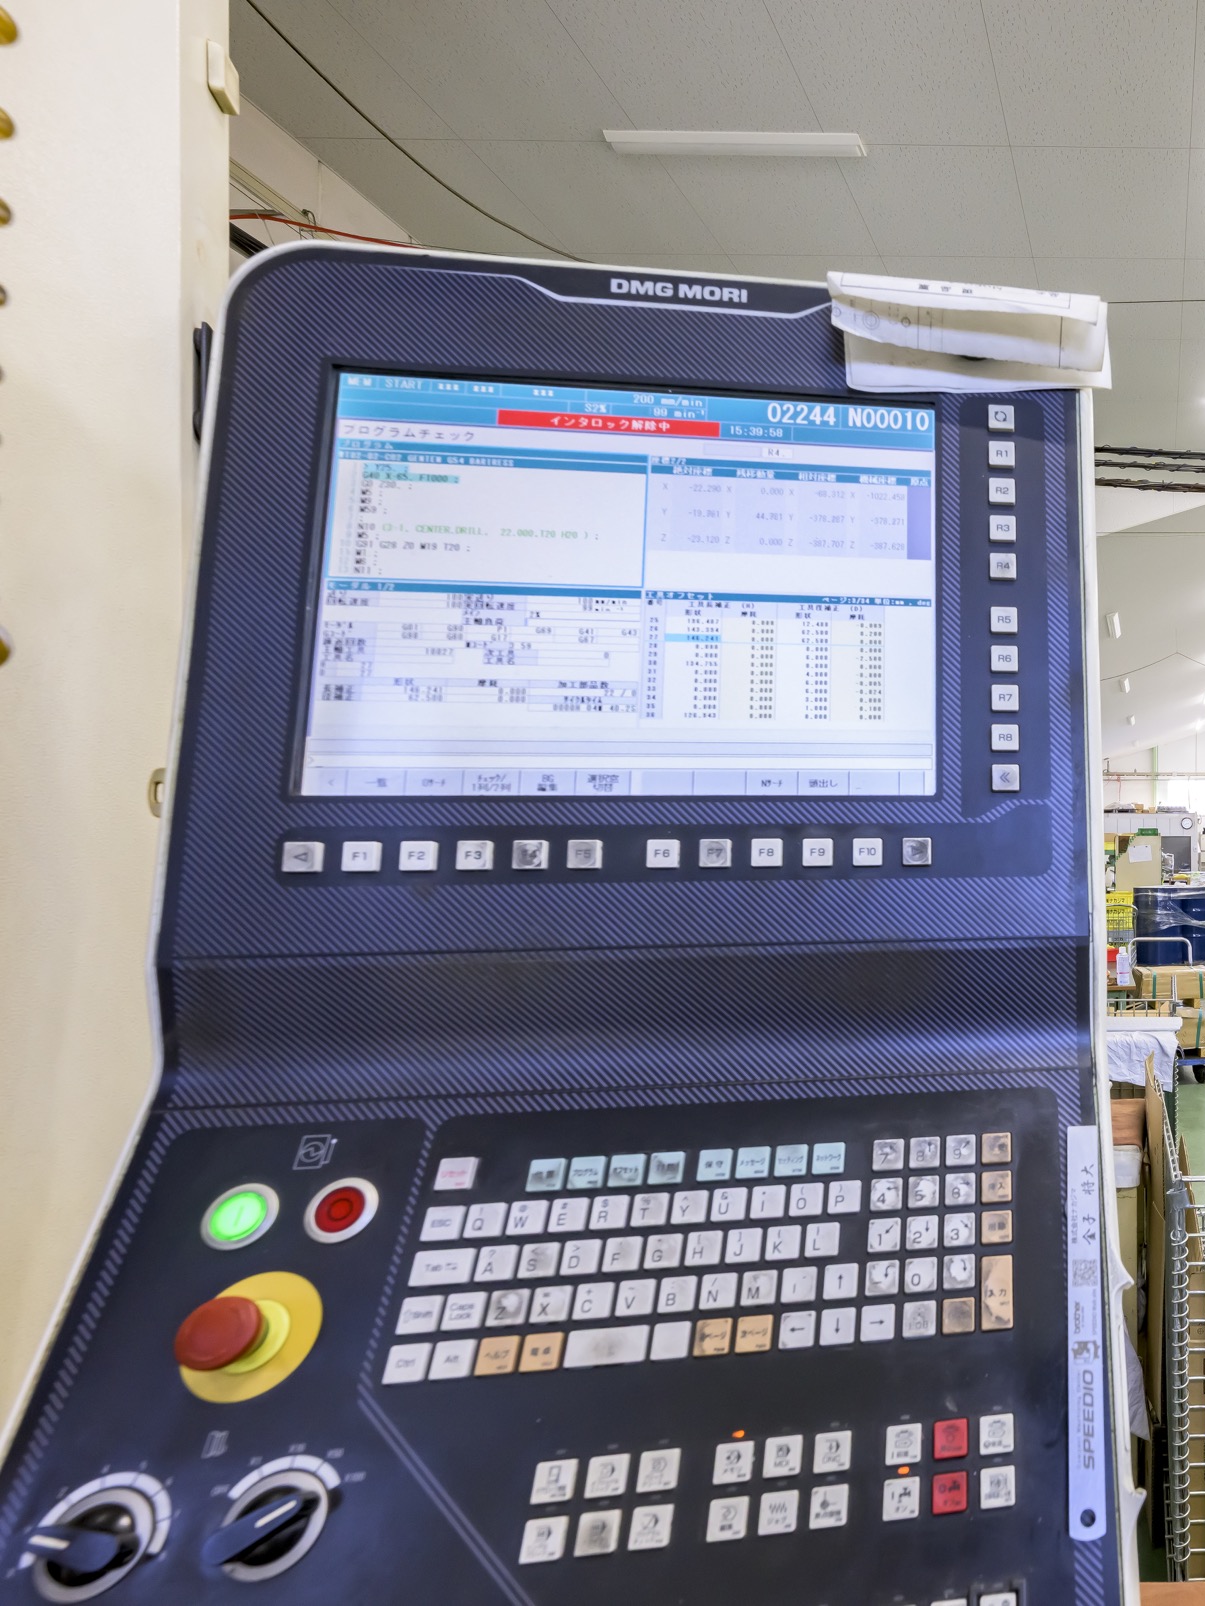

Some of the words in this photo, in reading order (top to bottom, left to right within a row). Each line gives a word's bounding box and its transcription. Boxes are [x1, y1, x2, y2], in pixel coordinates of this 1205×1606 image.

[610, 278, 674, 297] DMG
[678, 283, 748, 303] MORI
[384, 379, 423, 390] START
[549, 416, 671, 433] インタロック解除中
[848, 407, 929, 431] N00010
[343, 423, 476, 442] プログラムチェック
[729, 425, 784, 439] 15:39:58
[995, 449, 1009, 458] R1
[995, 486, 1010, 495] R2
[996, 523, 1010, 532] R3
[996, 561, 1011, 571] R4
[997, 615, 1012, 624] R5
[997, 654, 1012, 663] R6
[998, 693, 1013, 702] R7
[998, 733, 1013, 742] R8
[351, 851, 368, 861] F1
[407, 850, 426, 861] F2
[464, 850, 482, 860] F3
[653, 848, 671, 858] F6
[706, 848, 723, 857] F7
[758, 847, 775, 857] F8
[809, 847, 826, 857] F9
[858, 847, 877, 856] F10
[879, 1153, 889, 1164] 7
[915, 1150, 925, 1162] 8
[953, 1148, 962, 1159] 9
[795, 1197, 807, 1210] O
[834, 1195, 845, 1207] P
[876, 1193, 887, 1204] 4
[639, 1208, 650, 1220] T
[679, 1205, 691, 1217] Y
[717, 1202, 729, 1215] U
[513, 1216, 528, 1229] W
[556, 1213, 567, 1226] E
[597, 1211, 608, 1223] R
[471, 1217, 484, 1231] Q
[912, 1232, 922, 1243] 2
[950, 1229, 960, 1241] 3
[733, 1244, 743, 1257] J
[772, 1241, 783, 1254] K
[812, 1238, 821, 1251] L
[610, 1253, 621, 1265] F
[651, 1250, 663, 1262] G
[691, 1247, 704, 1260] H
[424, 1263, 443, 1273] Tab
[481, 1261, 494, 1275] A
[526, 1259, 538, 1272] S
[567, 1256, 580, 1269] D
[665, 1293, 676, 1306] B
[706, 1290, 718, 1303] N
[747, 1286, 760, 1300] M
[537, 1303, 550, 1317] X
[580, 1299, 592, 1313] C
[623, 1297, 636, 1310] V
[493, 1307, 506, 1320] Z
[444, 1354, 460, 1364] Alt
[1082, 1369, 1096, 1471] SPEEDIO
